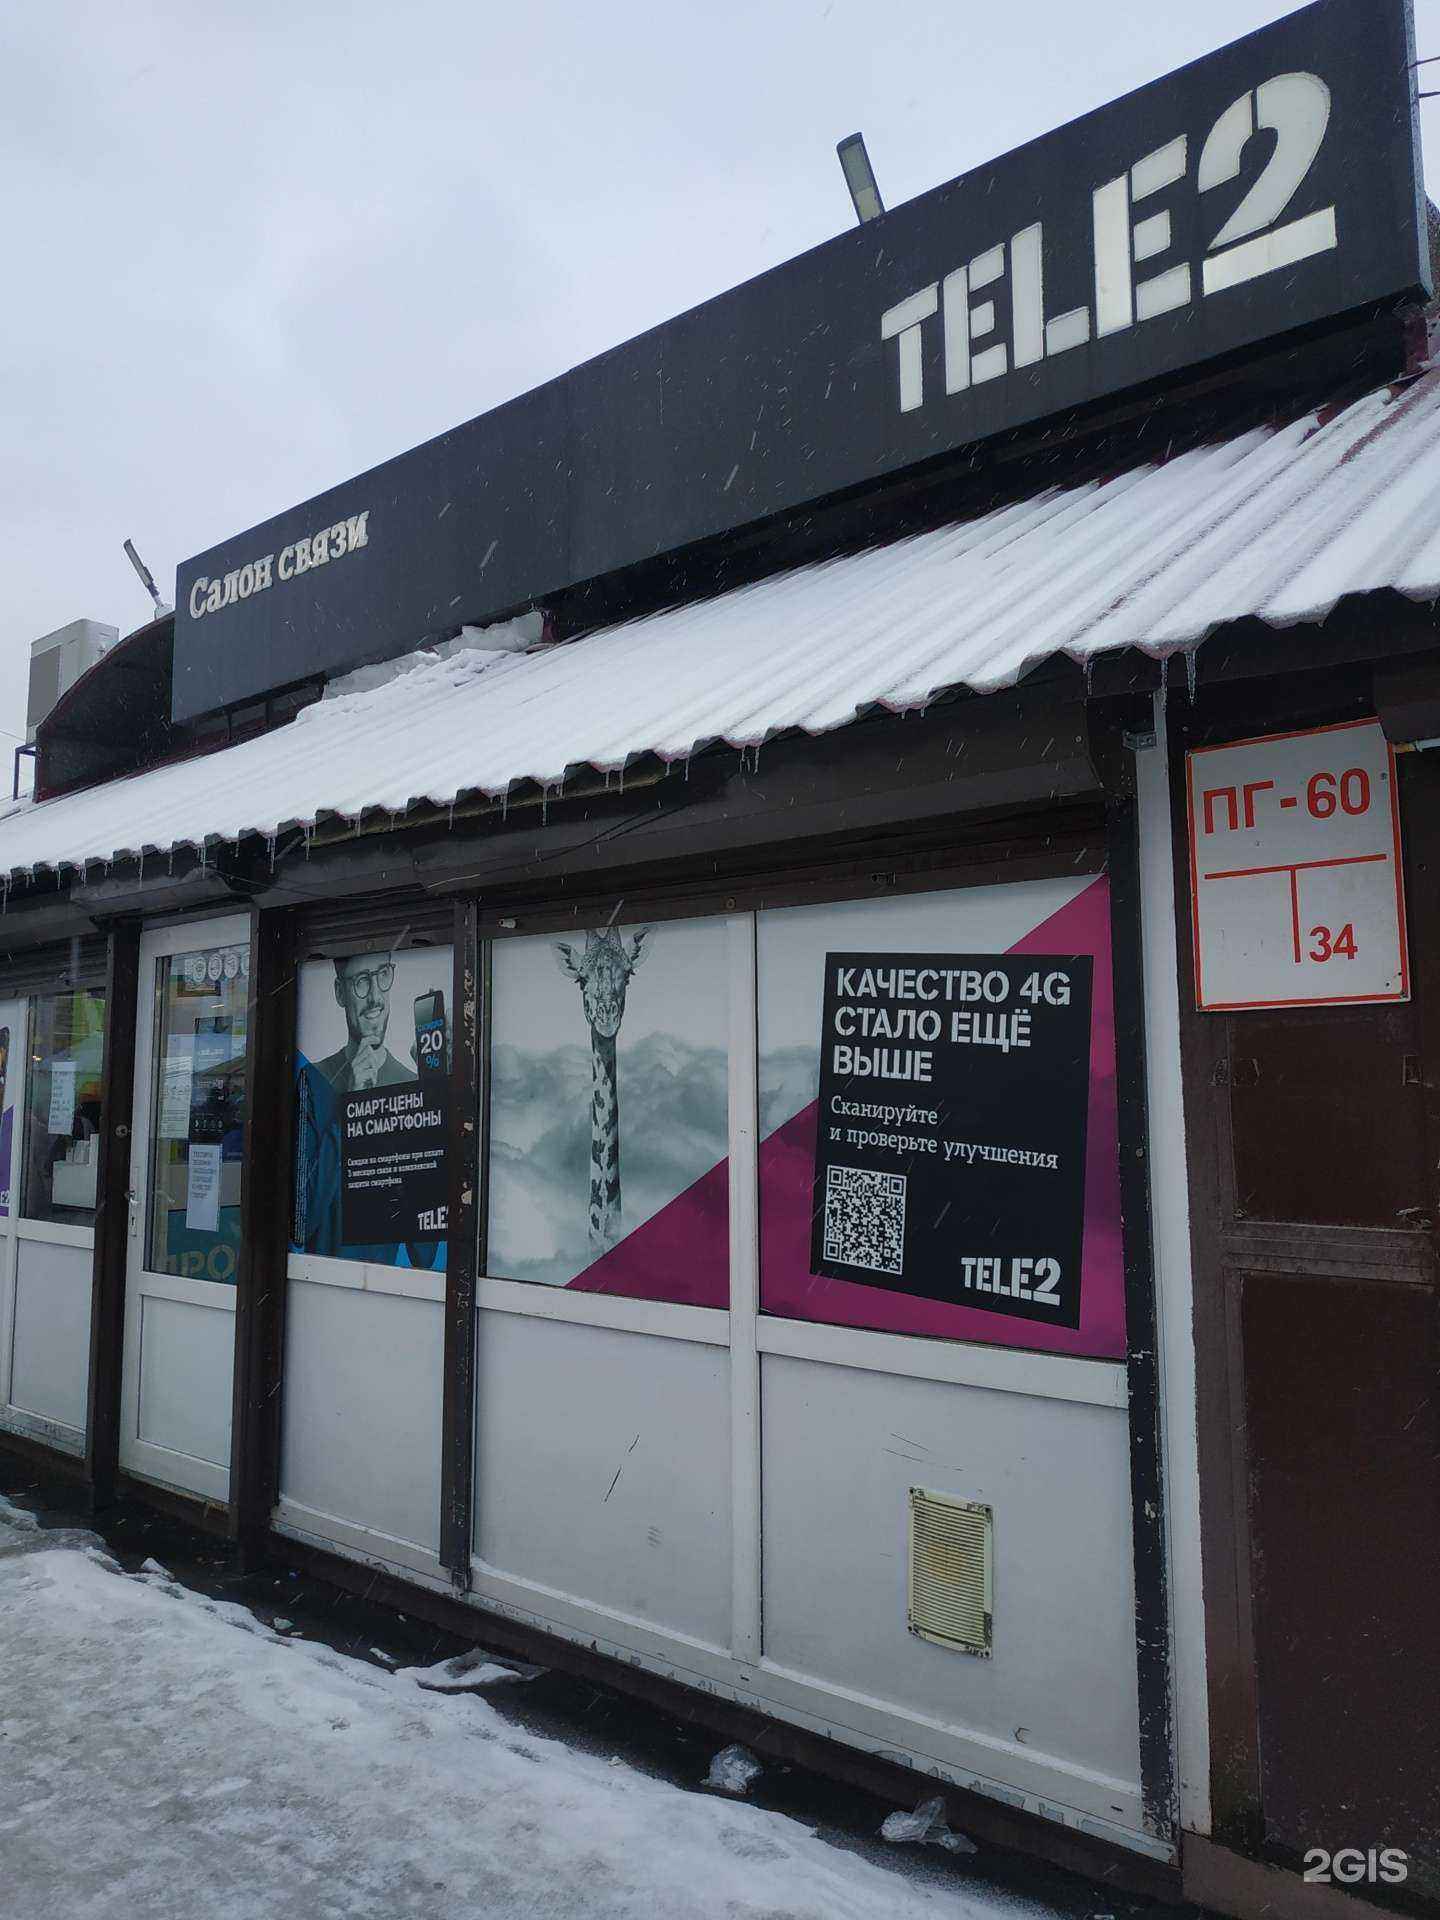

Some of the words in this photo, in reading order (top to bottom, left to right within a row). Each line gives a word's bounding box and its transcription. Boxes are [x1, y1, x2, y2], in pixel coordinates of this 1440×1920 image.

[881, 72, 1338, 413] TELE2
[189, 554, 274, 619] Салон
[278, 511, 370, 580] связи
[1203, 768, 1370, 834] ПГ-60
[1309, 924, 1358, 963] 34
[836, 967, 1010, 1003] КАЧЕСТВО
[1018, 971, 1071, 1006] 4G
[420, 1030, 443, 1055] 20
[834, 1006, 941, 1041] СТАЛО
[951, 1008, 1031, 1053] ЕЩЁ
[832, 1045, 933, 1082] ВЫШЕ
[346, 1091, 424, 1118] СМАРТ-ЦЕНЫ
[347, 1122, 364, 1138] НА
[365, 1109, 442, 1135] СМАРТФОНЫ
[830, 1095, 939, 1126] Сканируйте
[828, 1126, 842, 1141] и
[846, 1128, 938, 1155] проверьте
[943, 1139, 1059, 1170] улучшения
[417, 1206, 449, 1231] TELE
[960, 1257, 1061, 1307] TELE2
